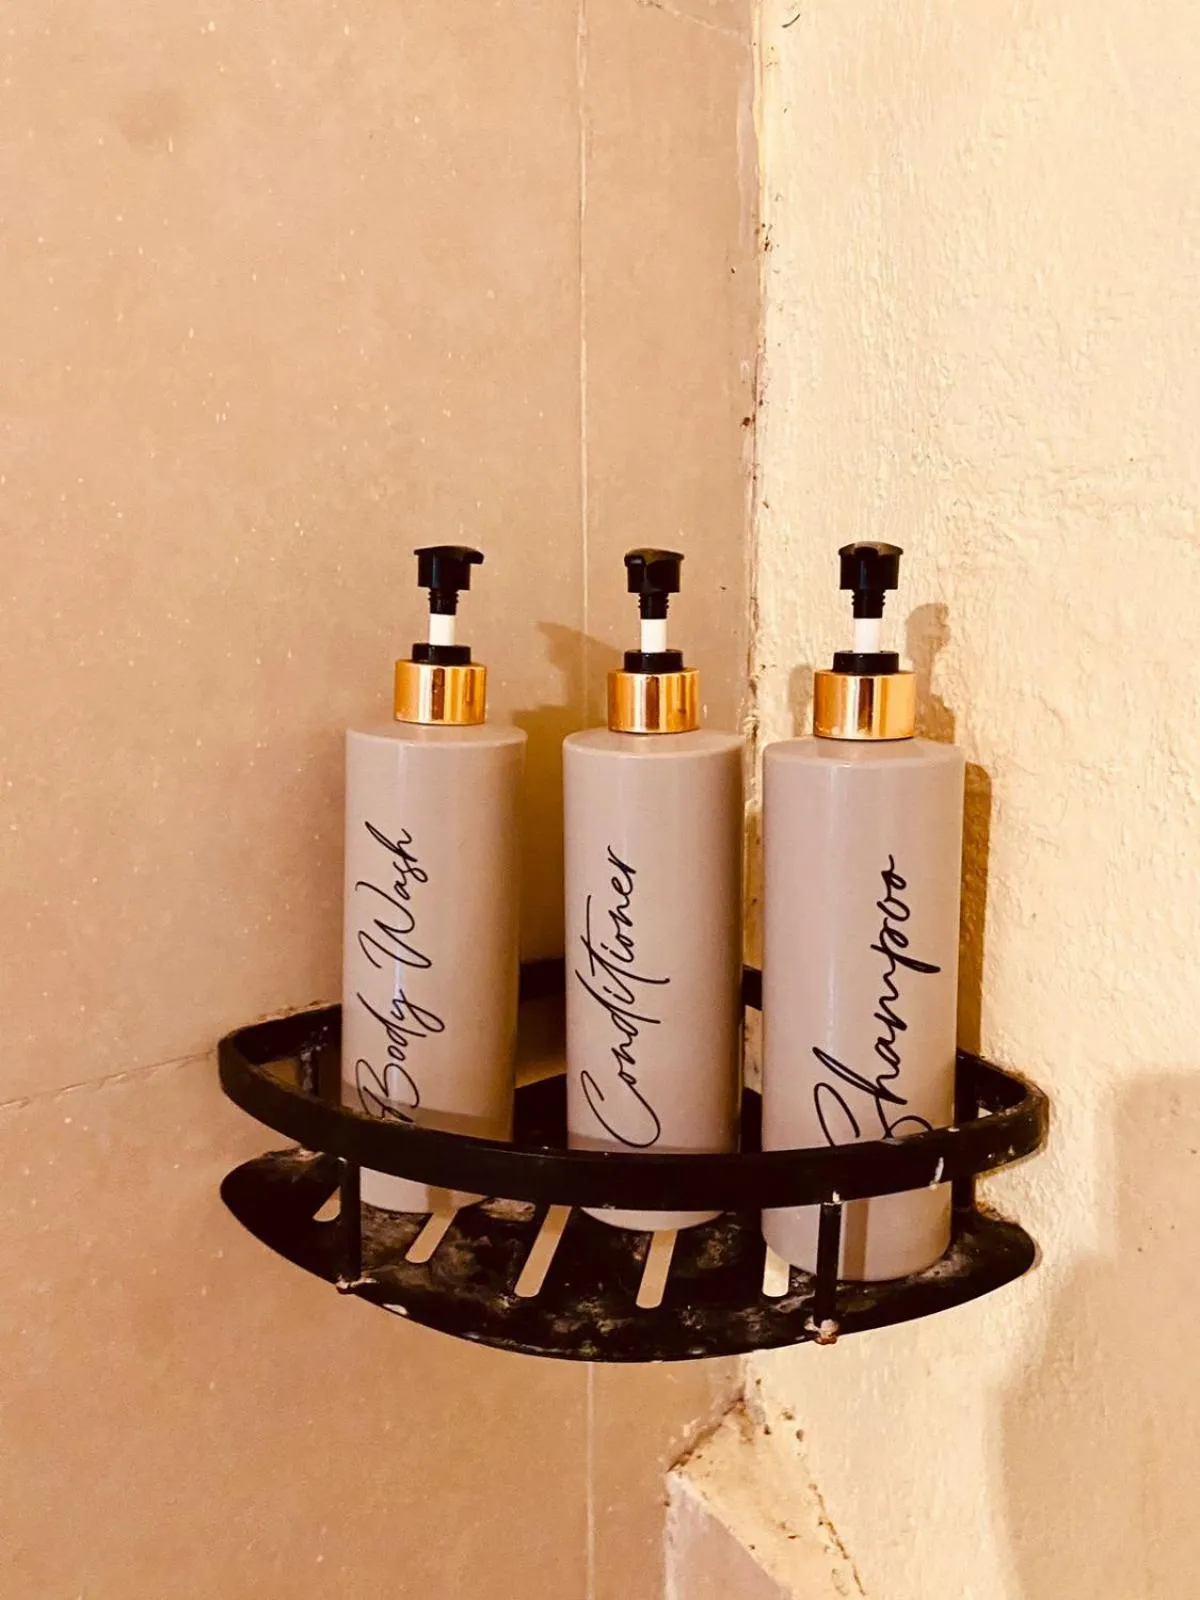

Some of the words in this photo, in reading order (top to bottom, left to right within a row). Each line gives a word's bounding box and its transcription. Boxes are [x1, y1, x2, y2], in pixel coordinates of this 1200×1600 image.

[355, 821, 433, 969] Wash
[575, 845, 670, 1149] Conditioner
[812, 854, 941, 1147] Shampoo
[355, 987, 445, 1123] Body
